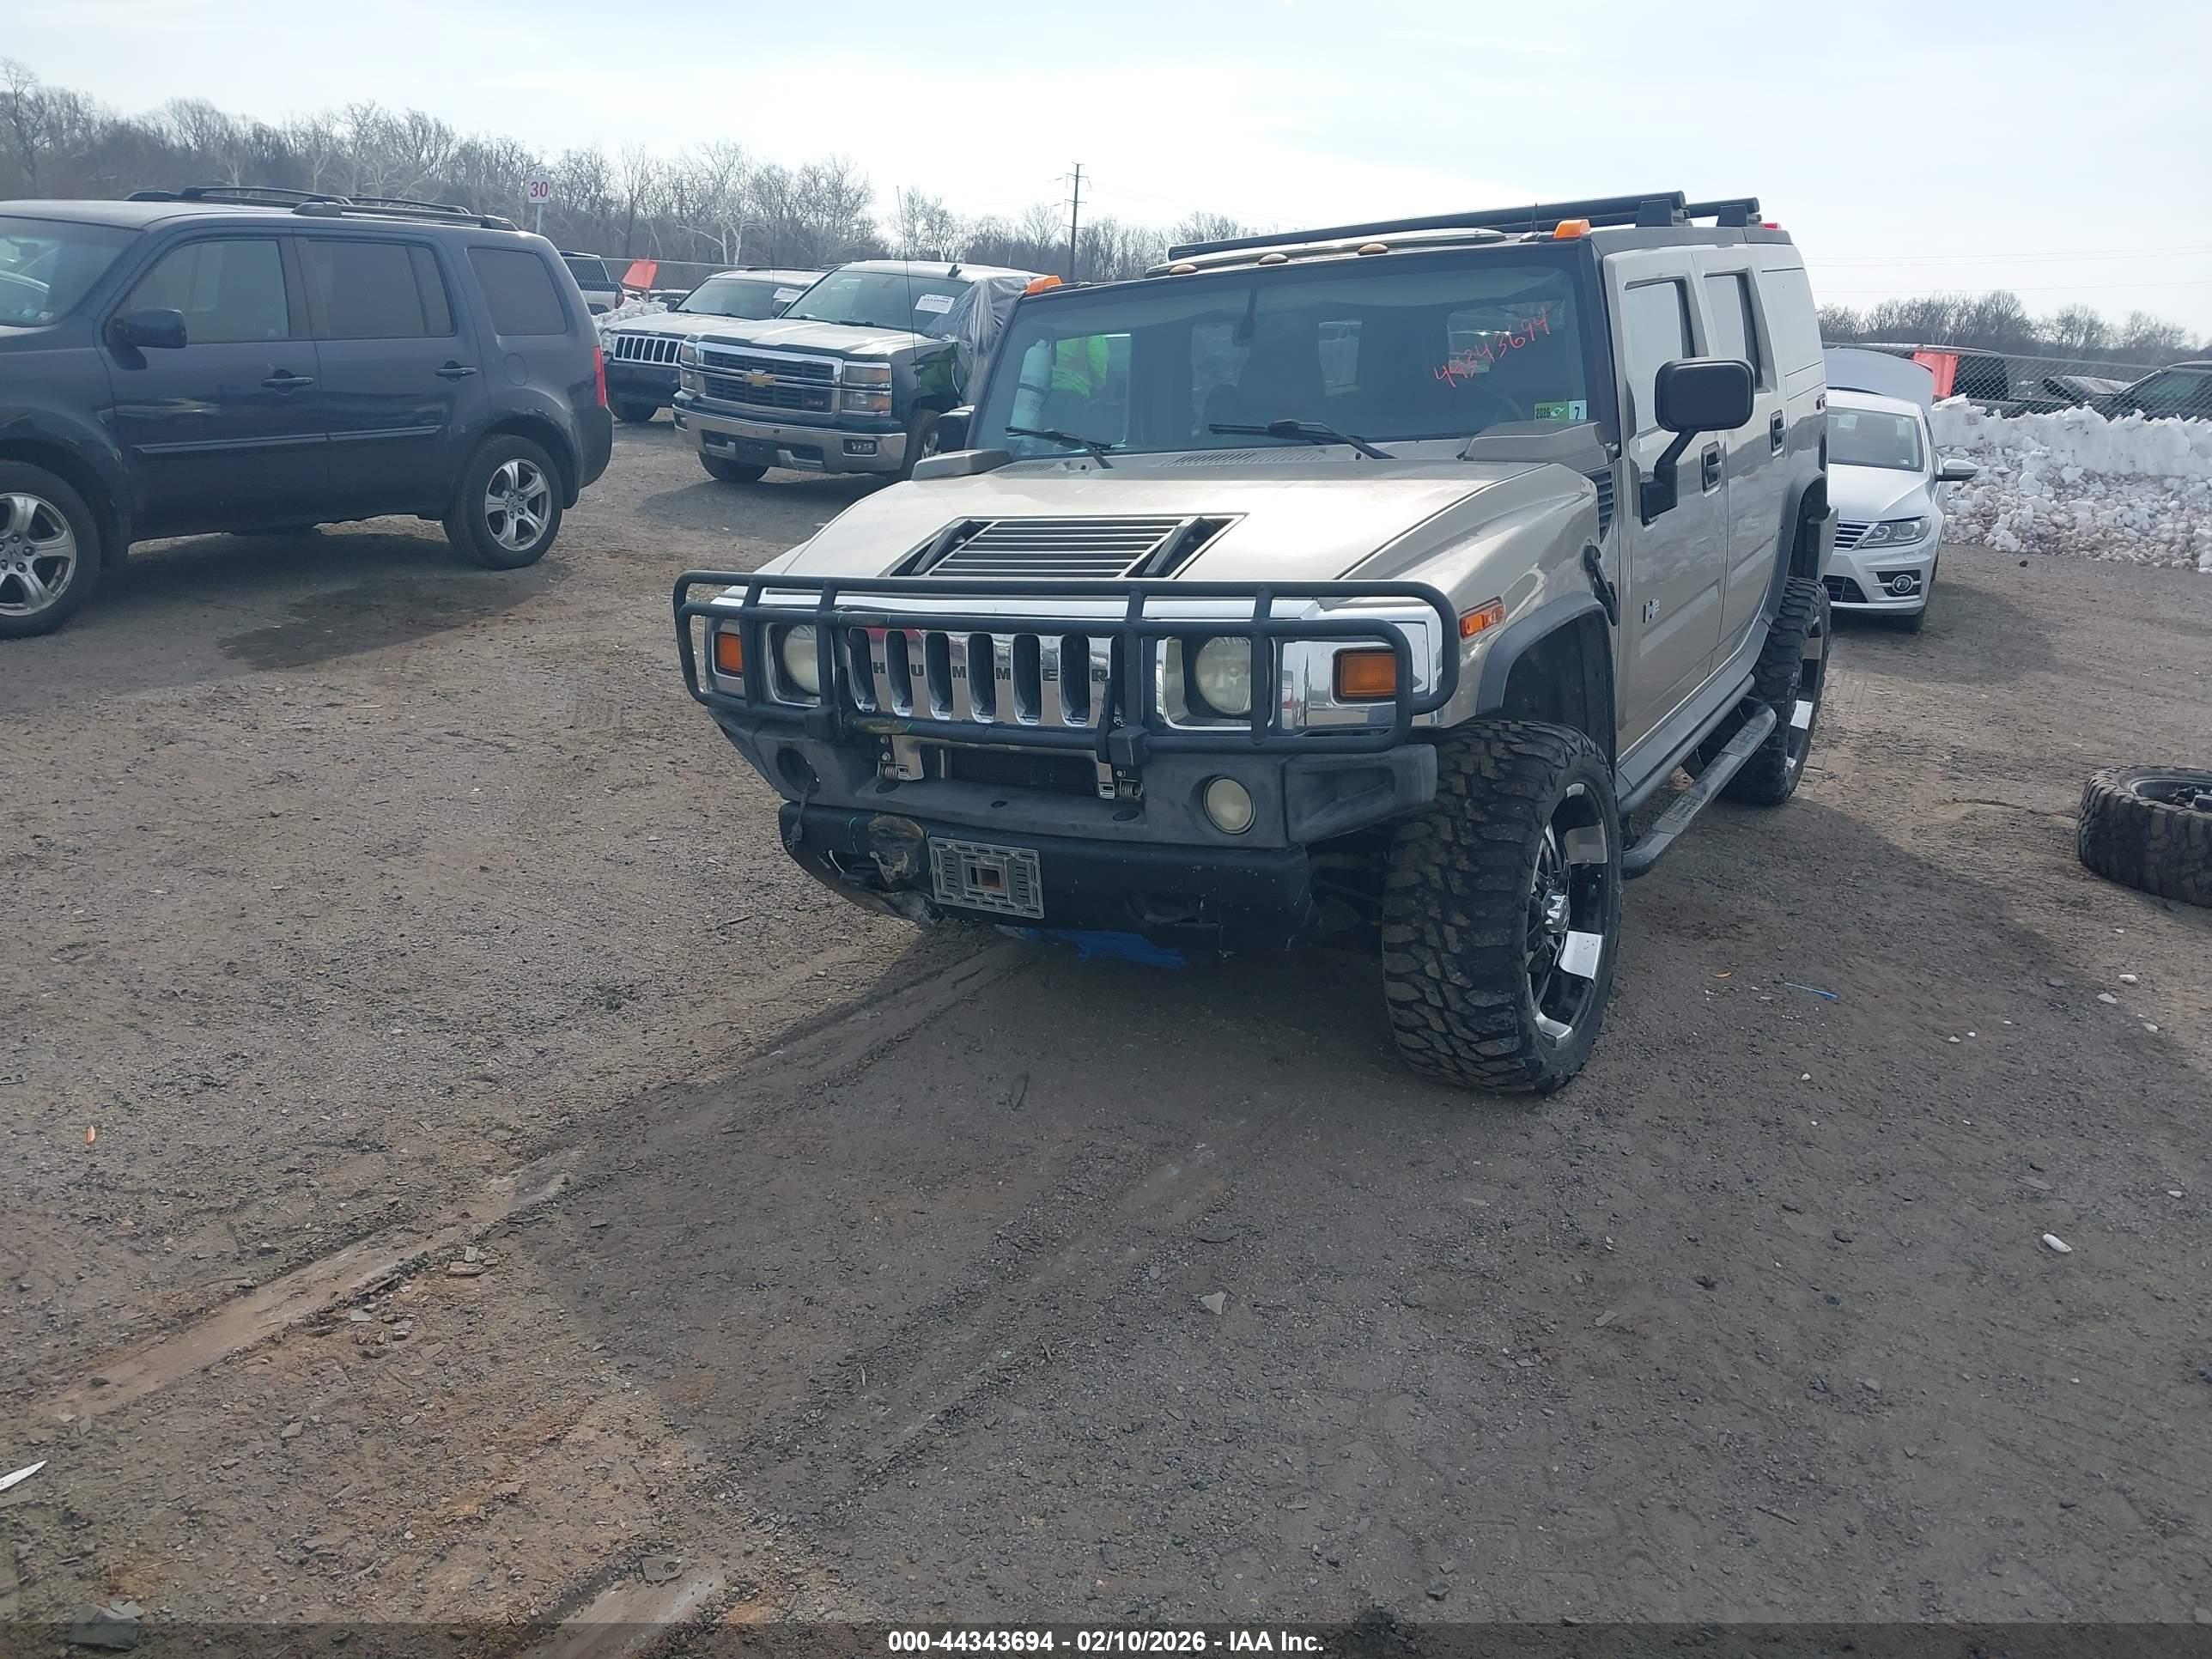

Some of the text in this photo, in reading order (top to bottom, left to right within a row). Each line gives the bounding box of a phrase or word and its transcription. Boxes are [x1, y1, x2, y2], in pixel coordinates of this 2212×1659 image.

[530, 181, 549, 198] 30
[1574, 405, 1581, 420] 7
[872, 661, 1109, 683] HUMMER
